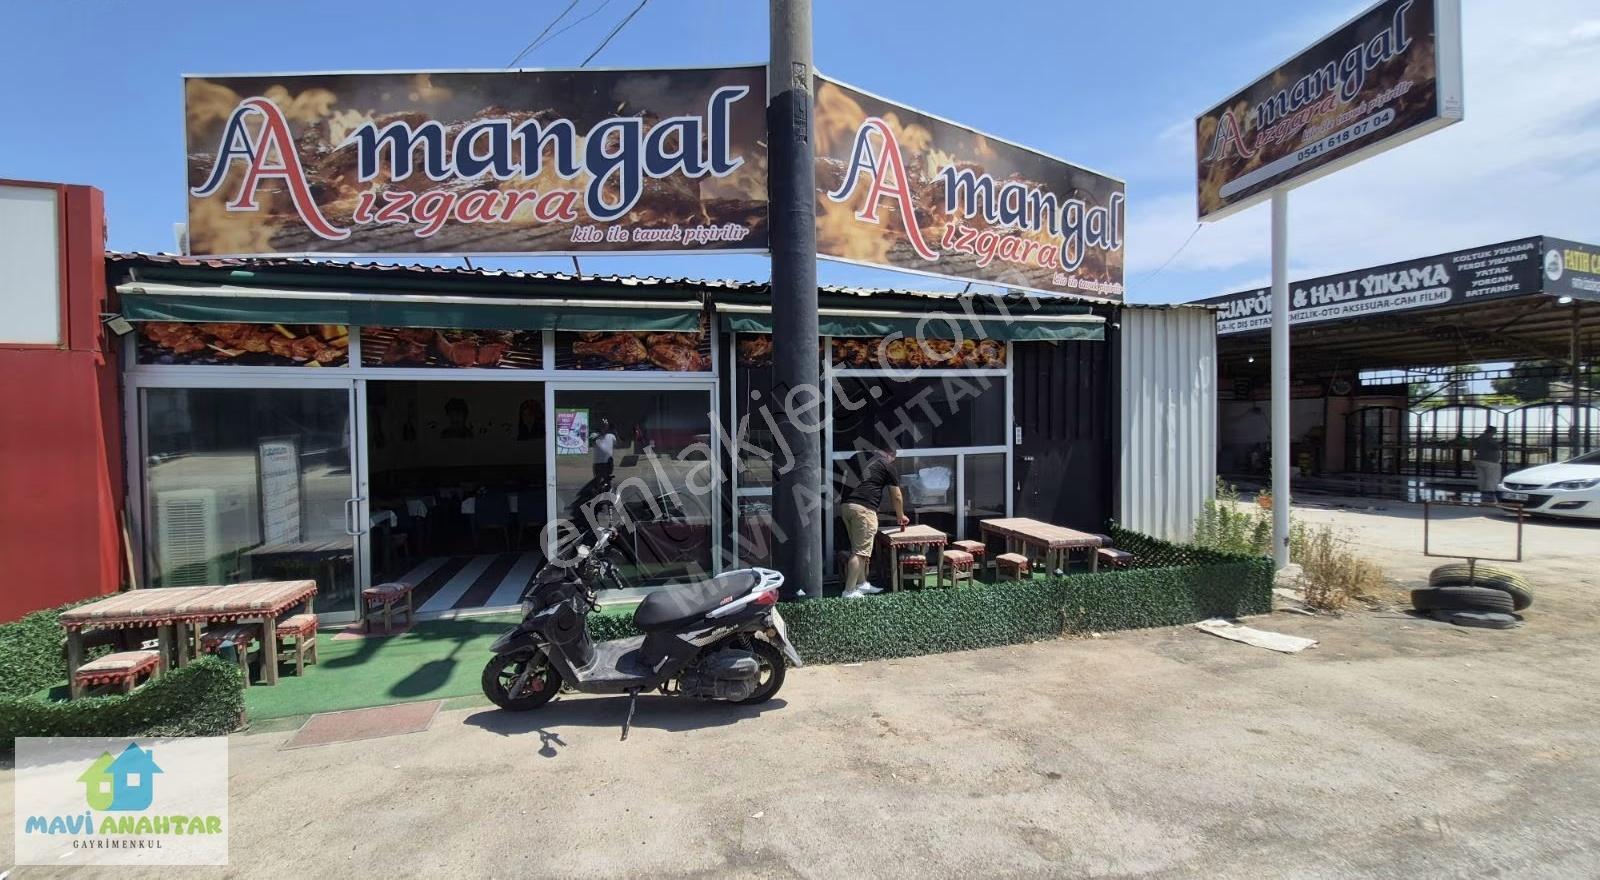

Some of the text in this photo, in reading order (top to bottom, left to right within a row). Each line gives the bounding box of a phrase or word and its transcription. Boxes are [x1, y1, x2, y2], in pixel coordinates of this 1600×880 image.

[1255, 0, 1414, 131] mangal
[350, 85, 750, 220] mangal
[1297, 112, 1390, 160] 0541 618 07 04
[570, 223, 750, 246] kilo ile tavuk pişirilir
[941, 163, 1124, 272] mangal
[1453, 242, 1534, 264] KOLTUK YIKAMA
[1458, 254, 1528, 272] PERDE YIKAMA
[1293, 288, 1308, 308] &
[1309, 278, 1359, 306] HALI
[1359, 263, 1450, 297] YIKAMA
[1472, 275, 1514, 288] YORGAN
[1475, 266, 1509, 278] YATAK
